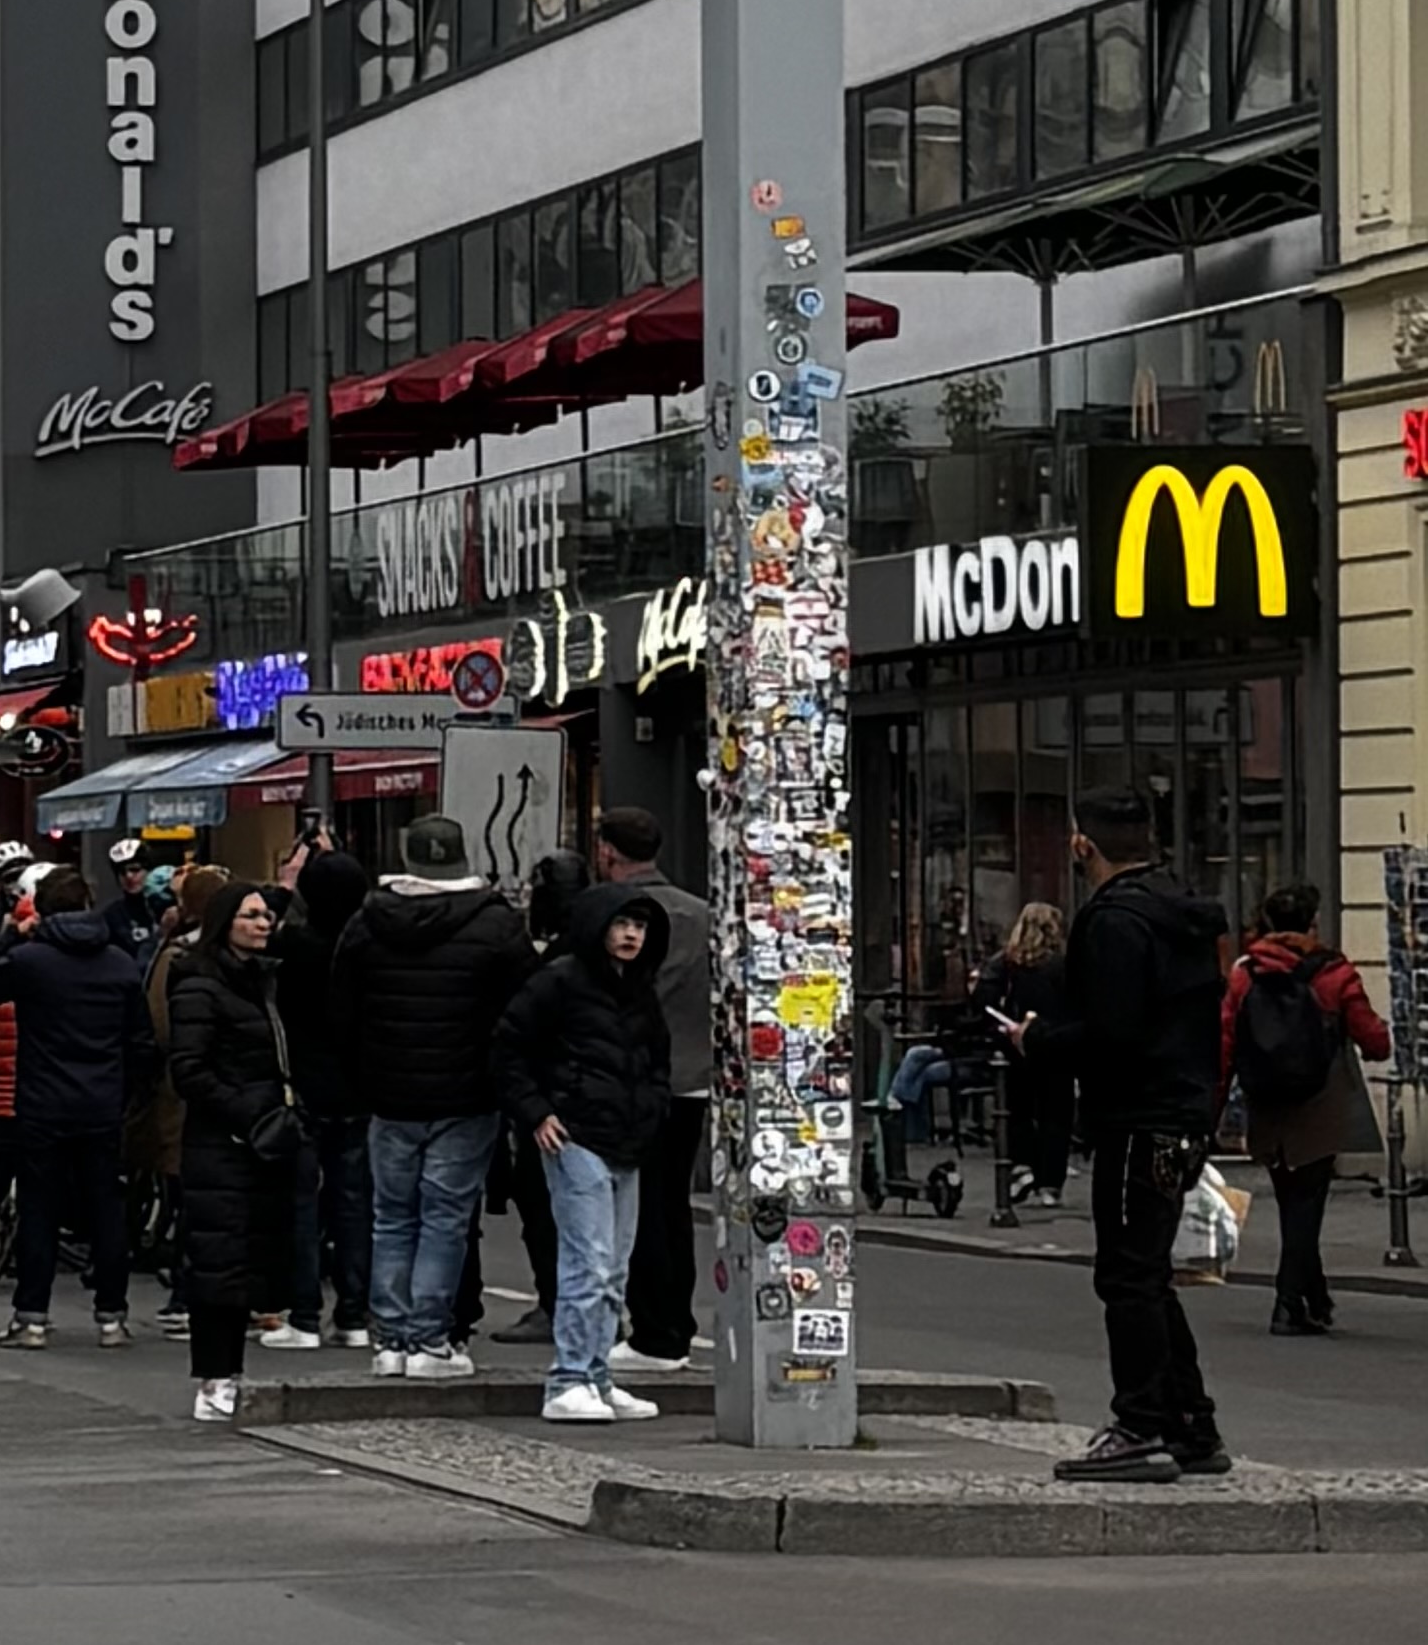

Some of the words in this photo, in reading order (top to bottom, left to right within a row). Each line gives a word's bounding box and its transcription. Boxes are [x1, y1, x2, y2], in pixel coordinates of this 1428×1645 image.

[37, 380, 212, 450] McCafé
[377, 495, 459, 618] SNACKS
[483, 472, 567, 601] COFFEE
[913, 534, 1081, 645] McDon
